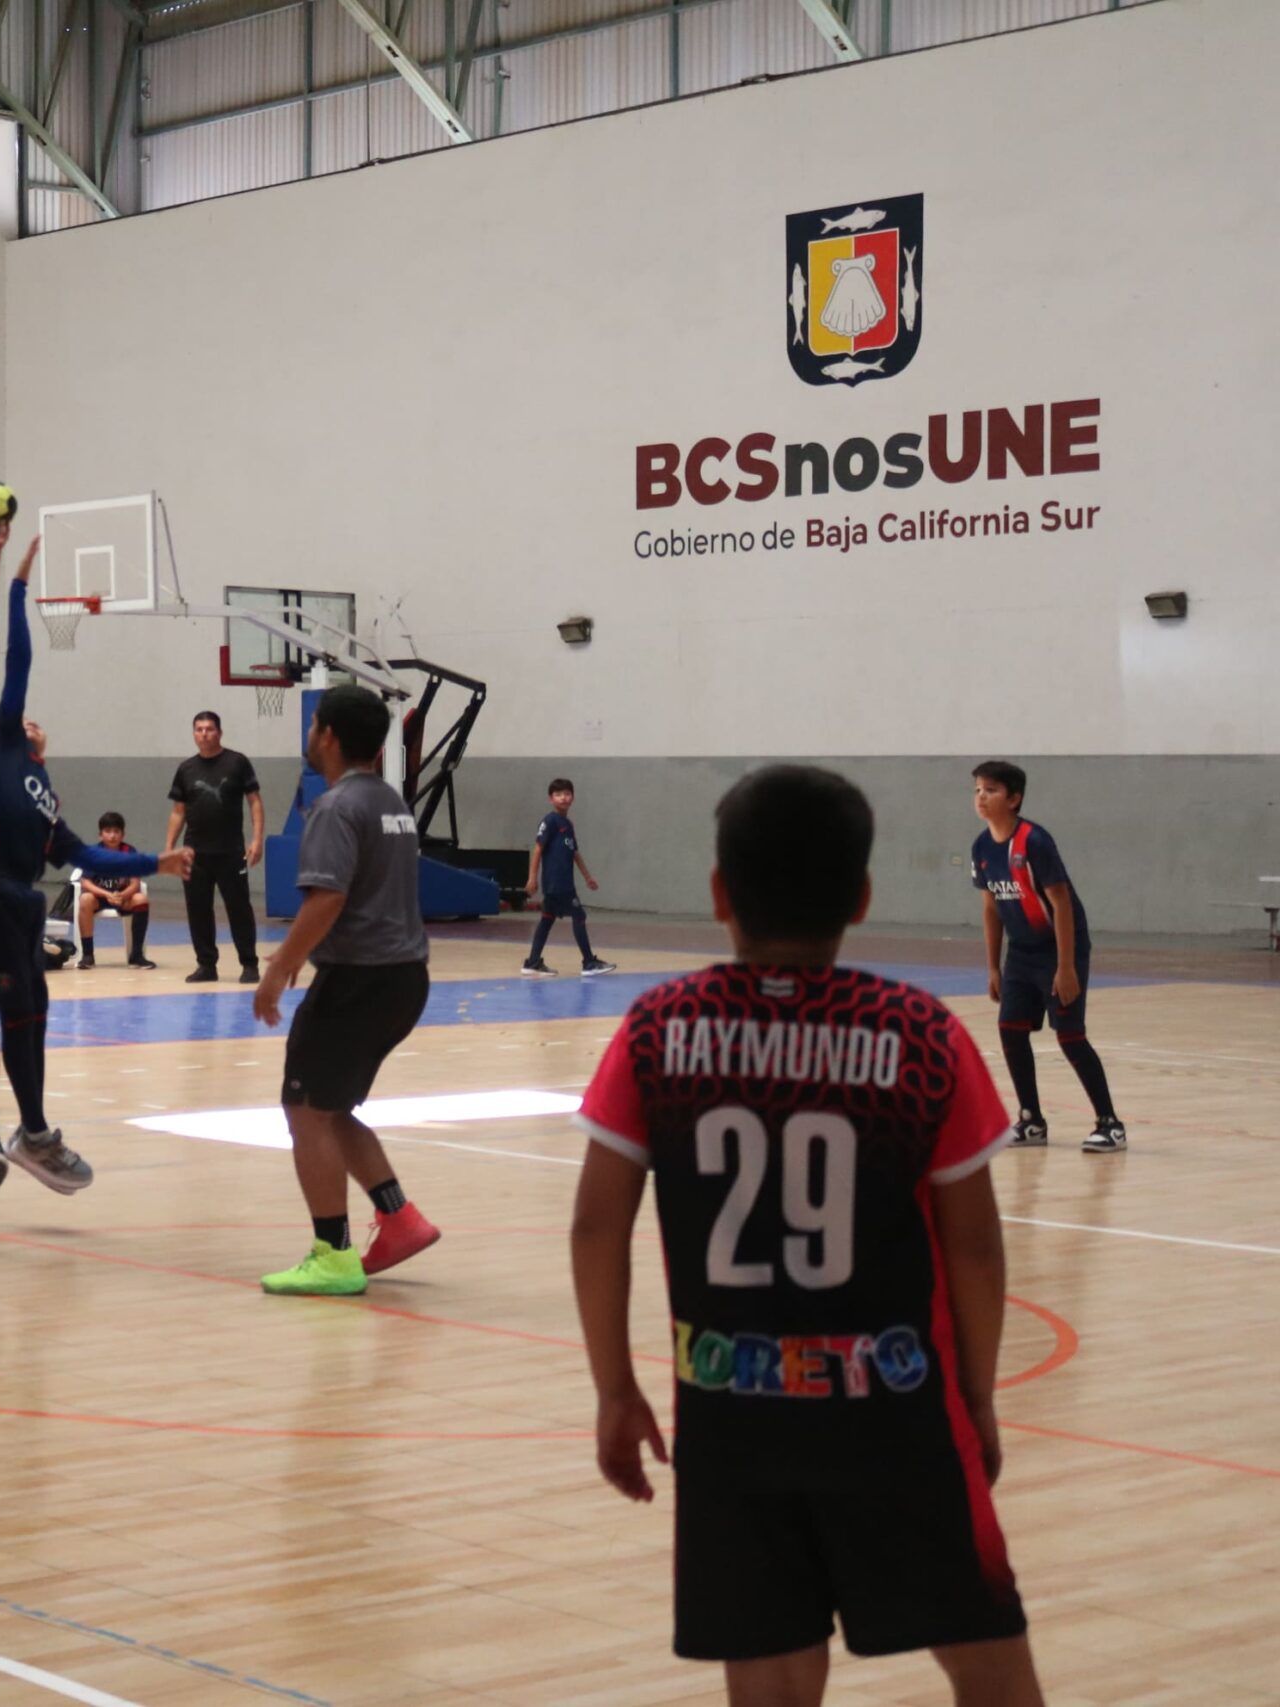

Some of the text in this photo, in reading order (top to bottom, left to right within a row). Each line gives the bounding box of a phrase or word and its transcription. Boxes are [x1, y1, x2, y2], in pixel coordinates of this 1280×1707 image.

[635, 398, 1101, 510] BCSnosUNE
[634, 501, 1101, 558] Gobierno de Baja California Sur
[663, 1016, 901, 1089] RAYMUNDO
[695, 1105, 857, 1290] 29
[673, 1321, 929, 1398] LORETO
